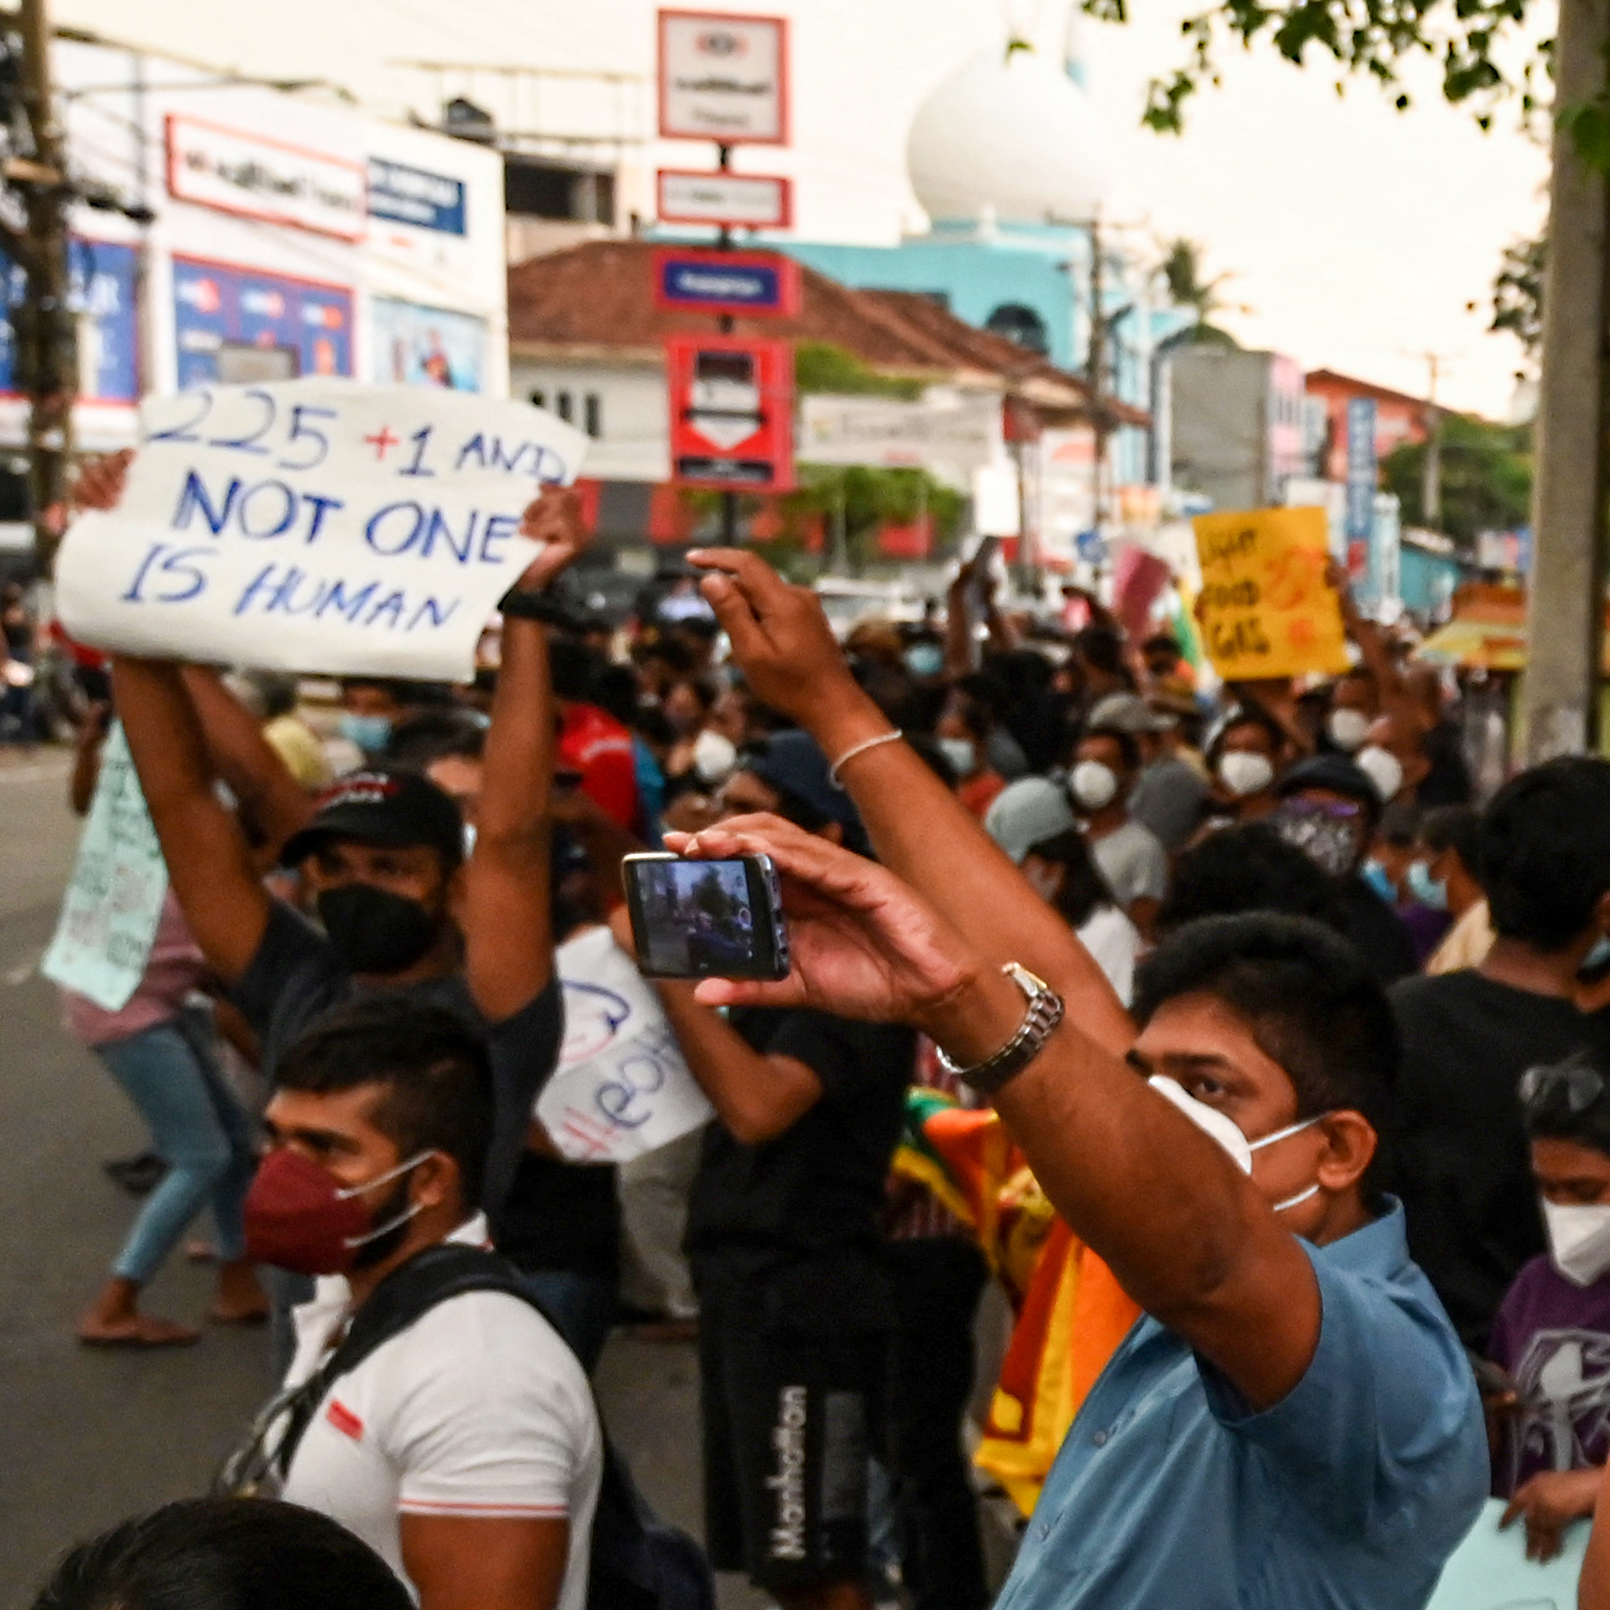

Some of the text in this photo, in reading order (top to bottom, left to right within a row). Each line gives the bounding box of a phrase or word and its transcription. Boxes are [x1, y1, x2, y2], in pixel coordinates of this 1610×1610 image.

[147, 390, 337, 471] 225
[171, 468, 522, 563] NOT ONE
[122, 544, 462, 630] IS HUMAN
